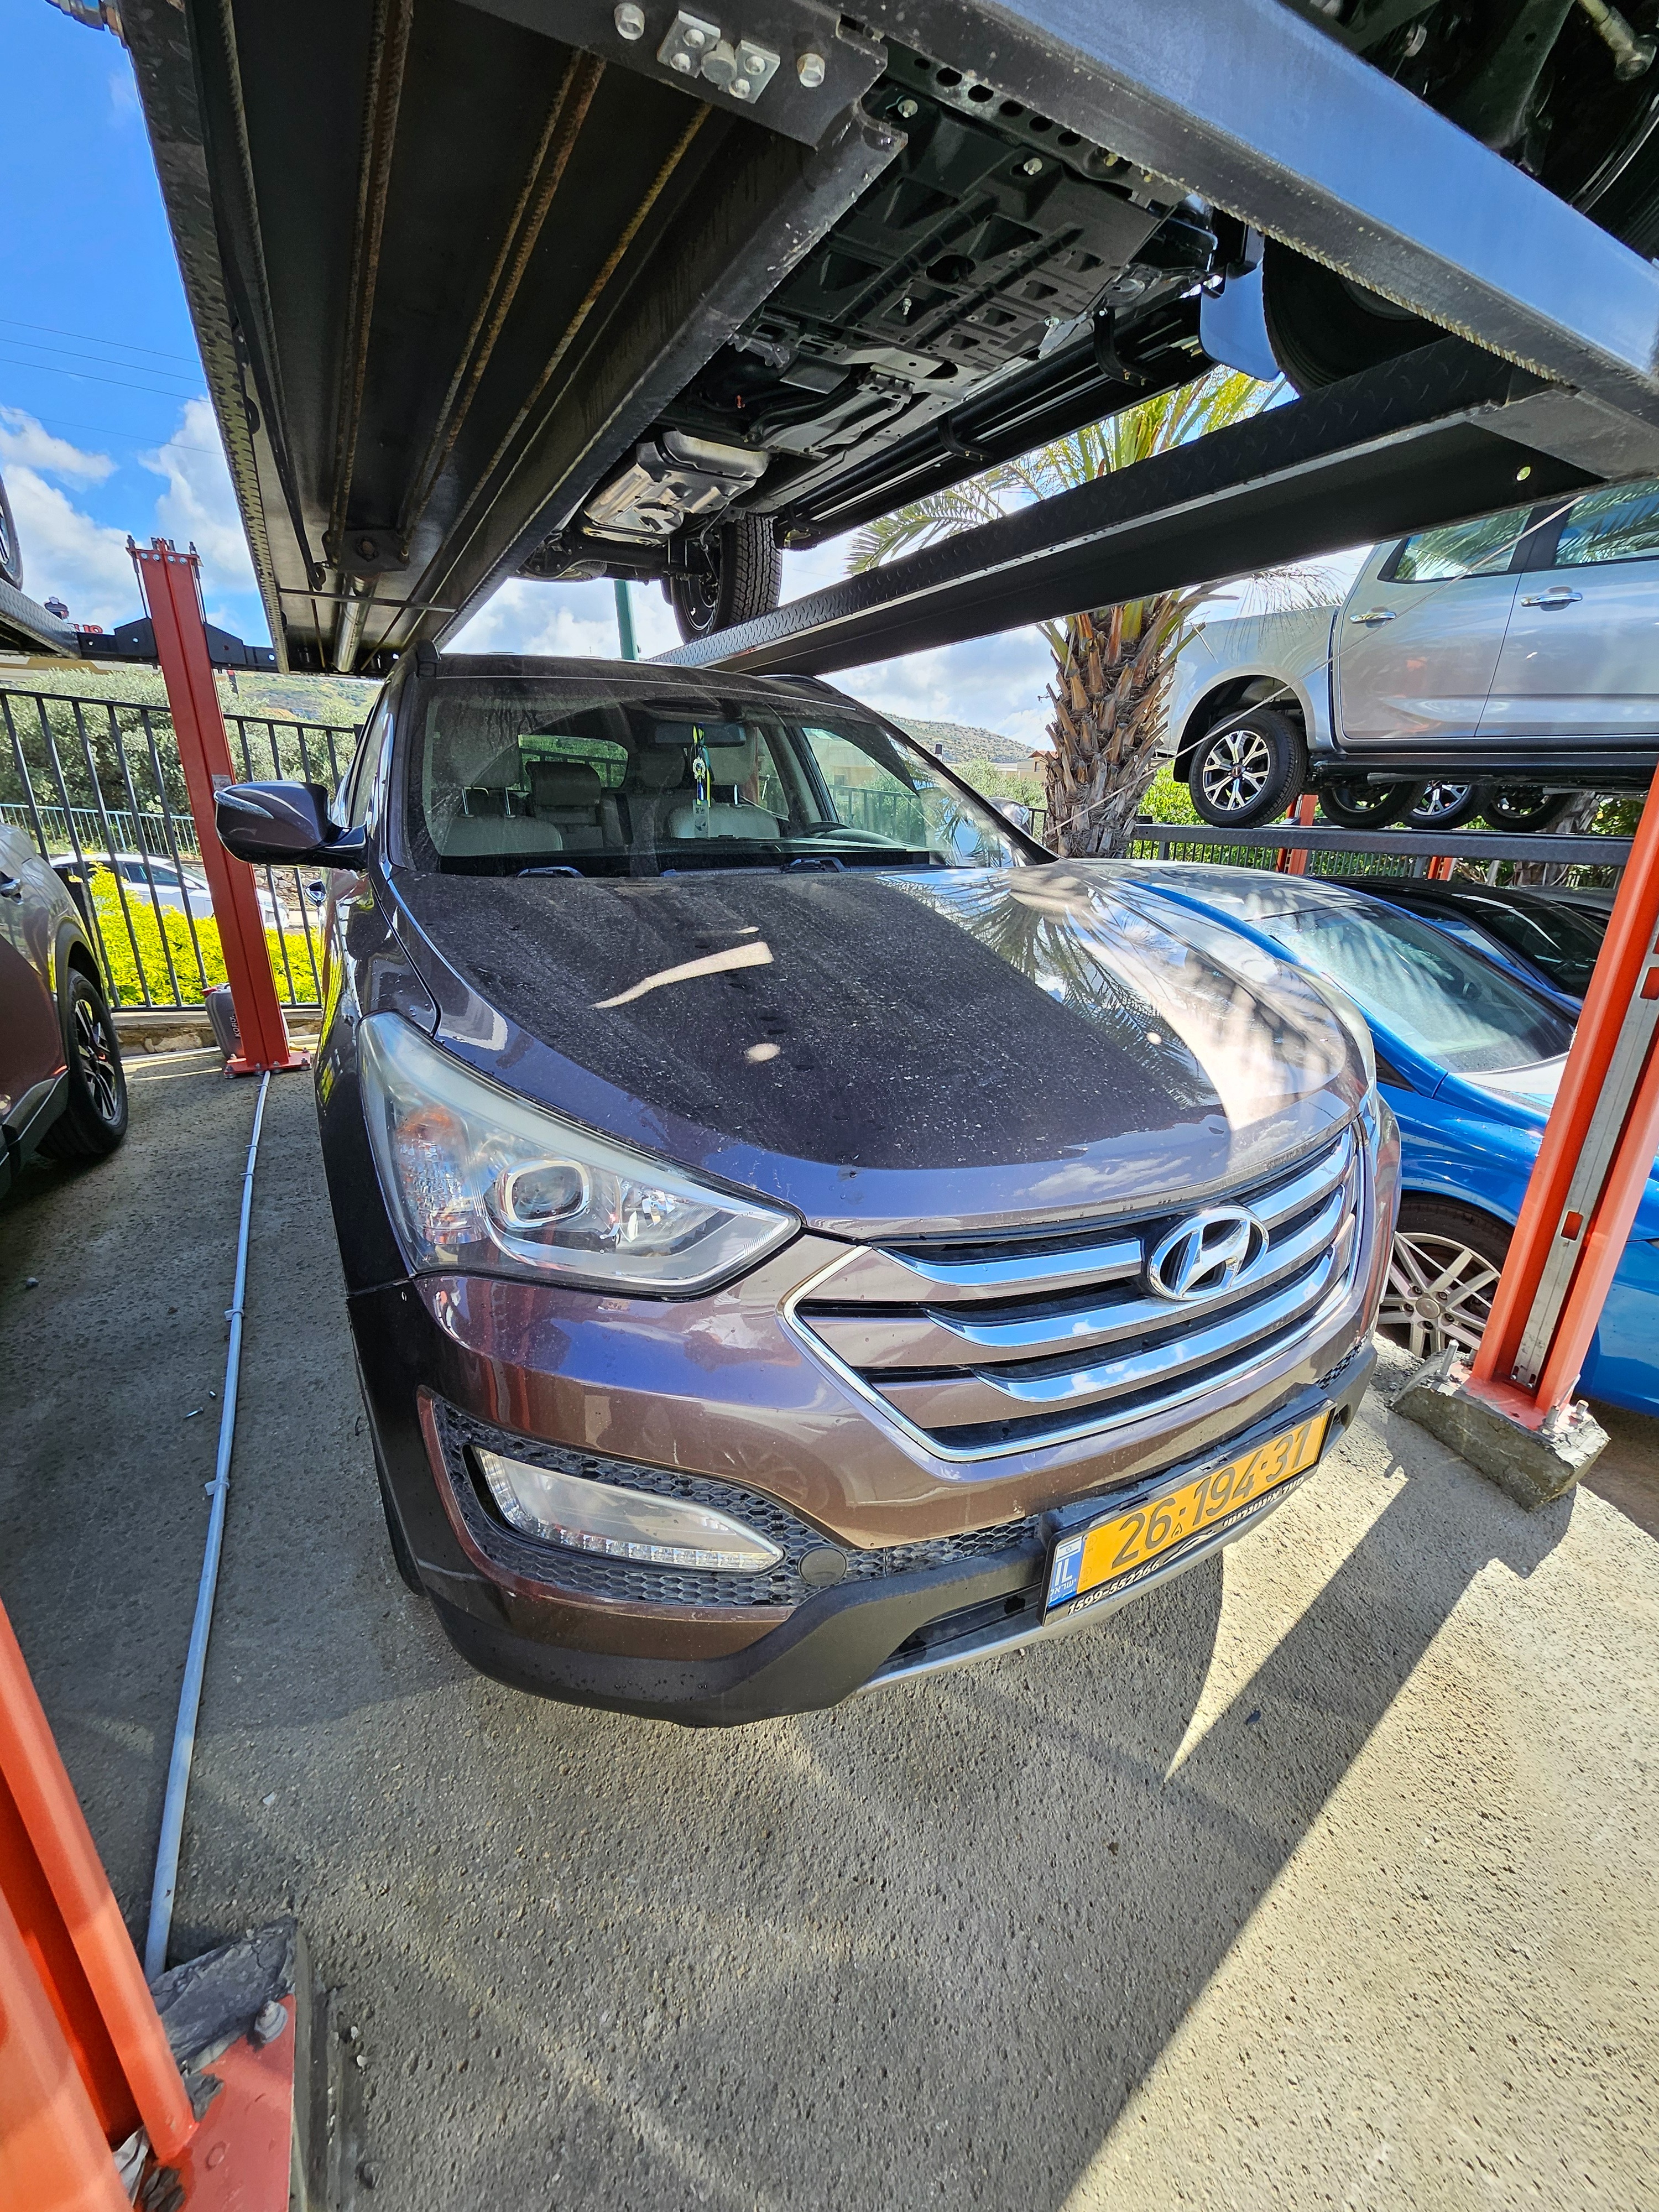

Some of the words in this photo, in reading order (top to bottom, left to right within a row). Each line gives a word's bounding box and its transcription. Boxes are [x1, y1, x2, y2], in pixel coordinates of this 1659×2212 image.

[1055, 1558, 1073, 1587] IL
[1068, 1559, 1160, 1615] 1599-552266
[1050, 1578, 1077, 1597] ישראל
